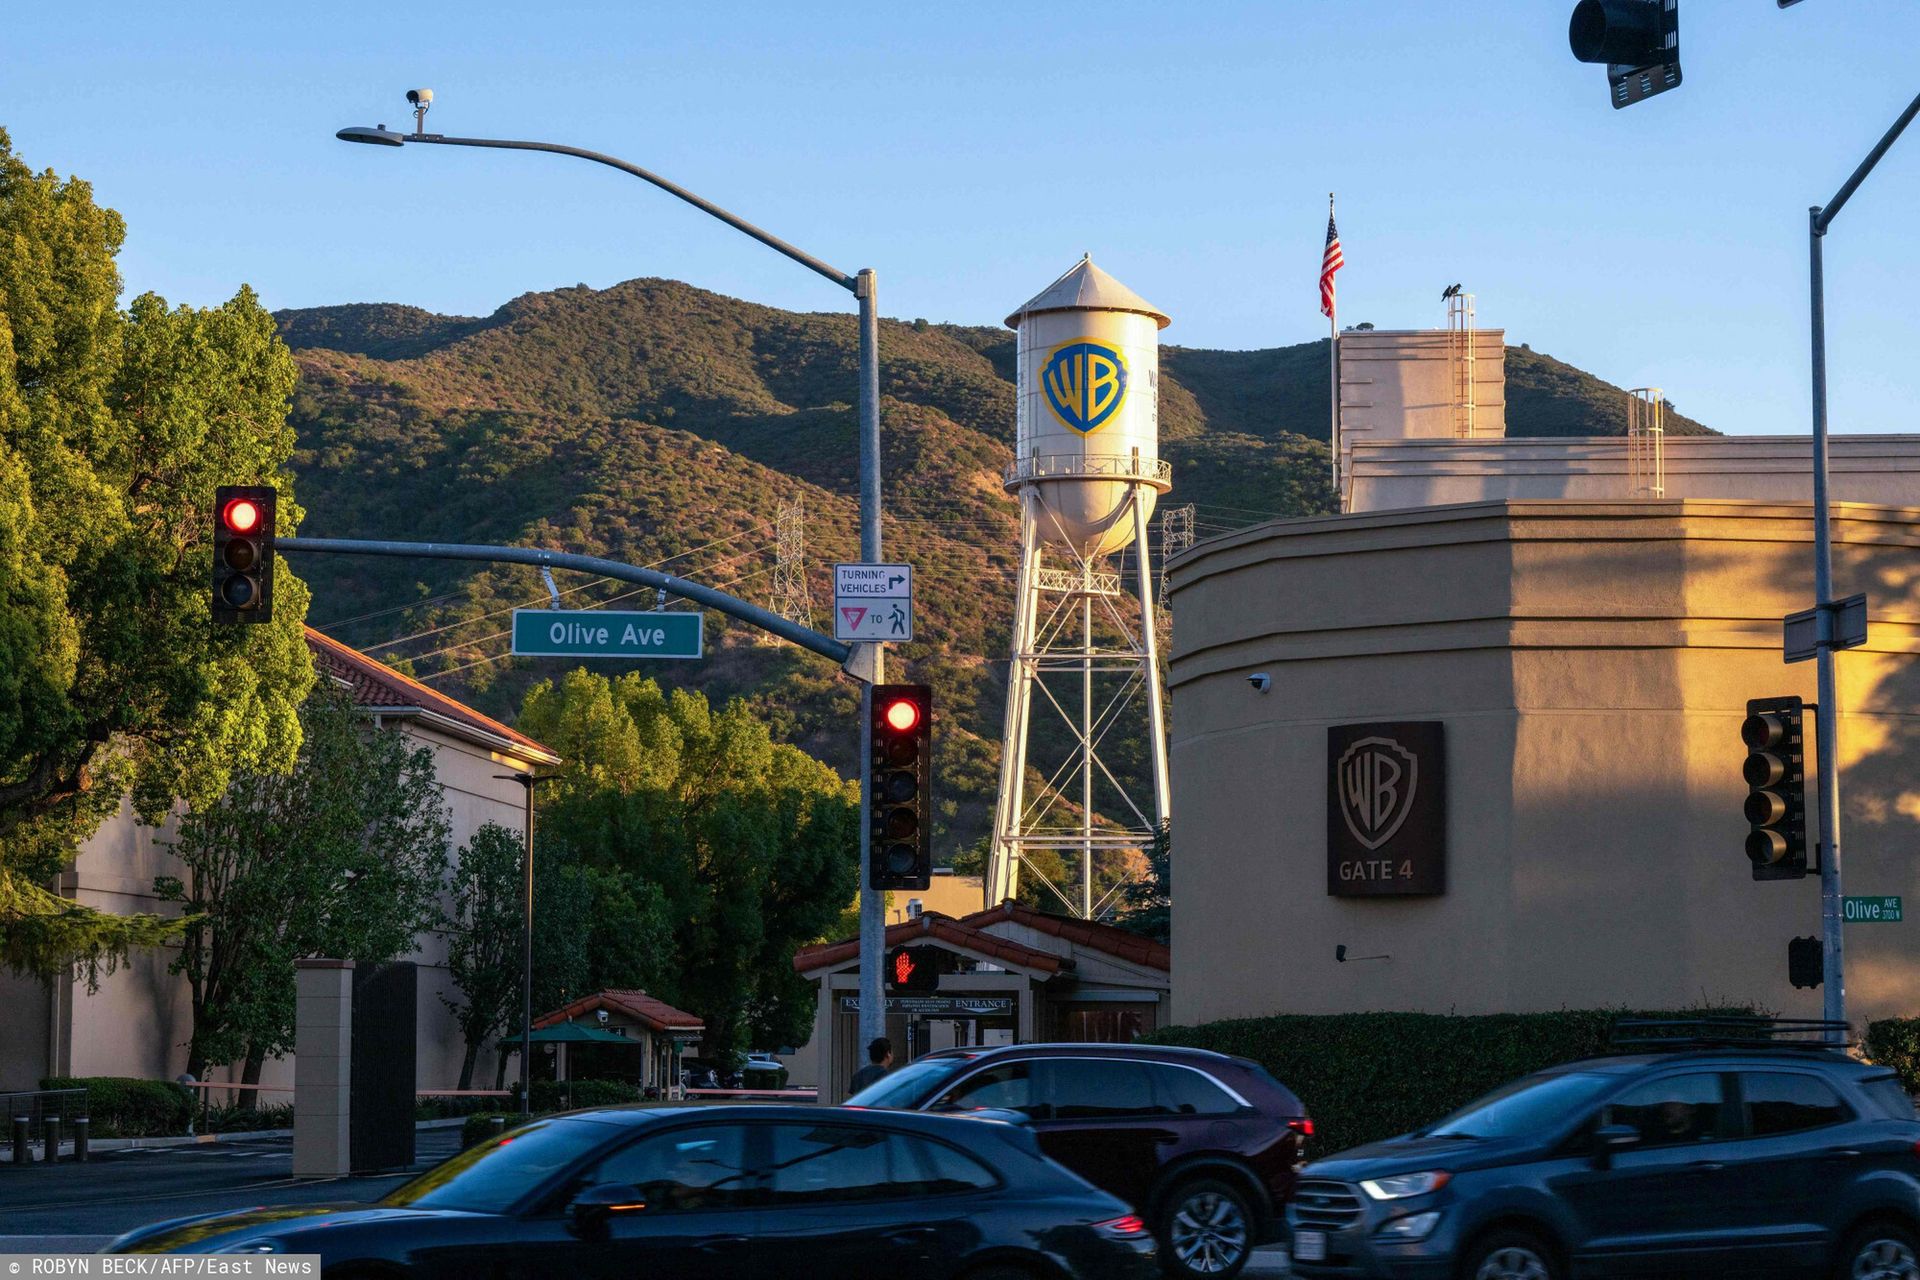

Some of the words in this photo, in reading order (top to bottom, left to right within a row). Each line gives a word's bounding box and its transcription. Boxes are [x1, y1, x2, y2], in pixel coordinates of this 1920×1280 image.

[1049, 353, 1119, 422] WB
[841, 570, 885, 579] TURNING
[840, 584, 886, 593] VEHICLES
[870, 614, 883, 624] TO
[549, 621, 609, 645] Olive
[620, 623, 666, 646] Ave
[1347, 752, 1402, 832] WB
[1339, 860, 1393, 880] GATE
[1398, 859, 1413, 879] 4
[1845, 900, 1880, 919] Olive
[1884, 898, 1897, 908] AVE
[955, 1000, 1007, 1009] ENTRANCE
